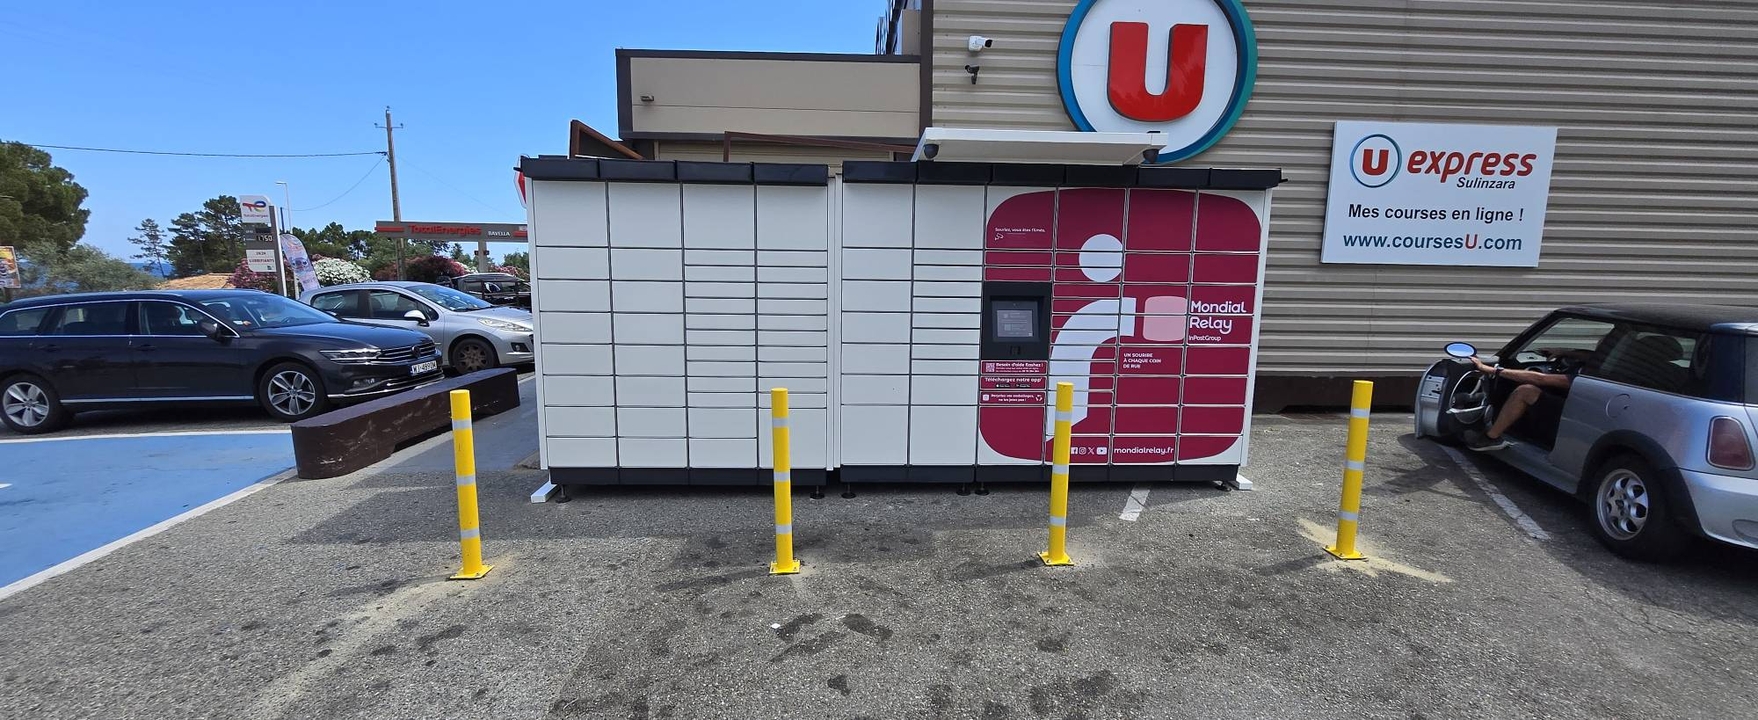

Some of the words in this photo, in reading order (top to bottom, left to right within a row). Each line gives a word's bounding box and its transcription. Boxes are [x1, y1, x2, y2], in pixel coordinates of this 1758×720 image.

[1107, 21, 1209, 122] U
[1362, 148, 1389, 176] U
[1407, 150, 1537, 183] express
[1457, 177, 1516, 190] Sulinzara
[1348, 204, 1379, 218] Mes
[1384, 206, 1447, 220] courses
[1452, 209, 1470, 220] en
[1475, 207, 1514, 224] ligne
[1518, 208, 1524, 221] !
[408, 224, 482, 237] TotalEnergies
[1343, 234, 1522, 250] www.coursesU.com
[1190, 301, 1247, 313] Mondial
[1189, 316, 1232, 334] Relay
[1114, 447, 1174, 455] mondialrelay.fr
